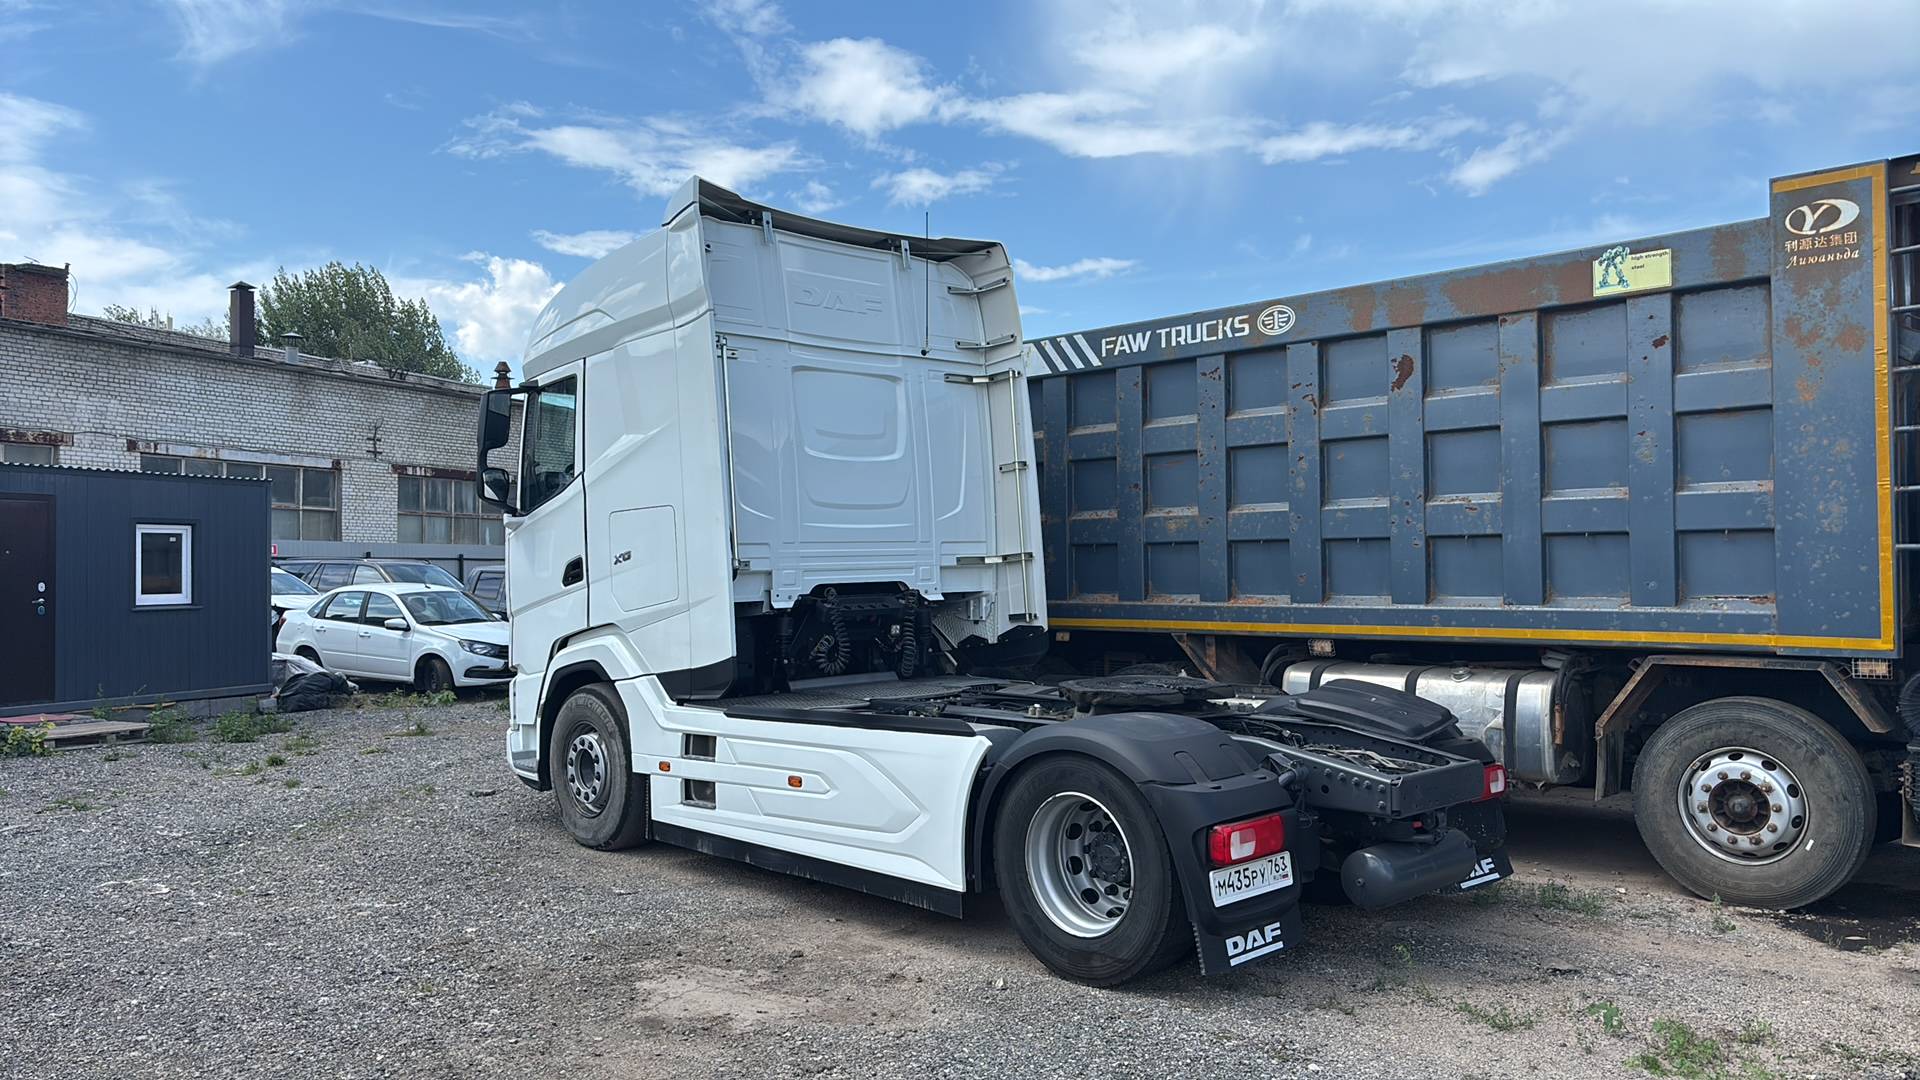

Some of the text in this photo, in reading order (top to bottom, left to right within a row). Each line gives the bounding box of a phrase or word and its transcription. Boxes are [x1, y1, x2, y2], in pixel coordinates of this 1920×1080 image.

[1784, 231, 1857, 253] 利源达集团
[1785, 247, 1860, 269] Лиюаньда
[793, 287, 884, 316] DAF
[1101, 314, 1249, 358] FAW TRUCKS
[1268, 856, 1287, 876] 763
[1467, 857, 1495, 879] AF
[1225, 922, 1282, 957] DAF
